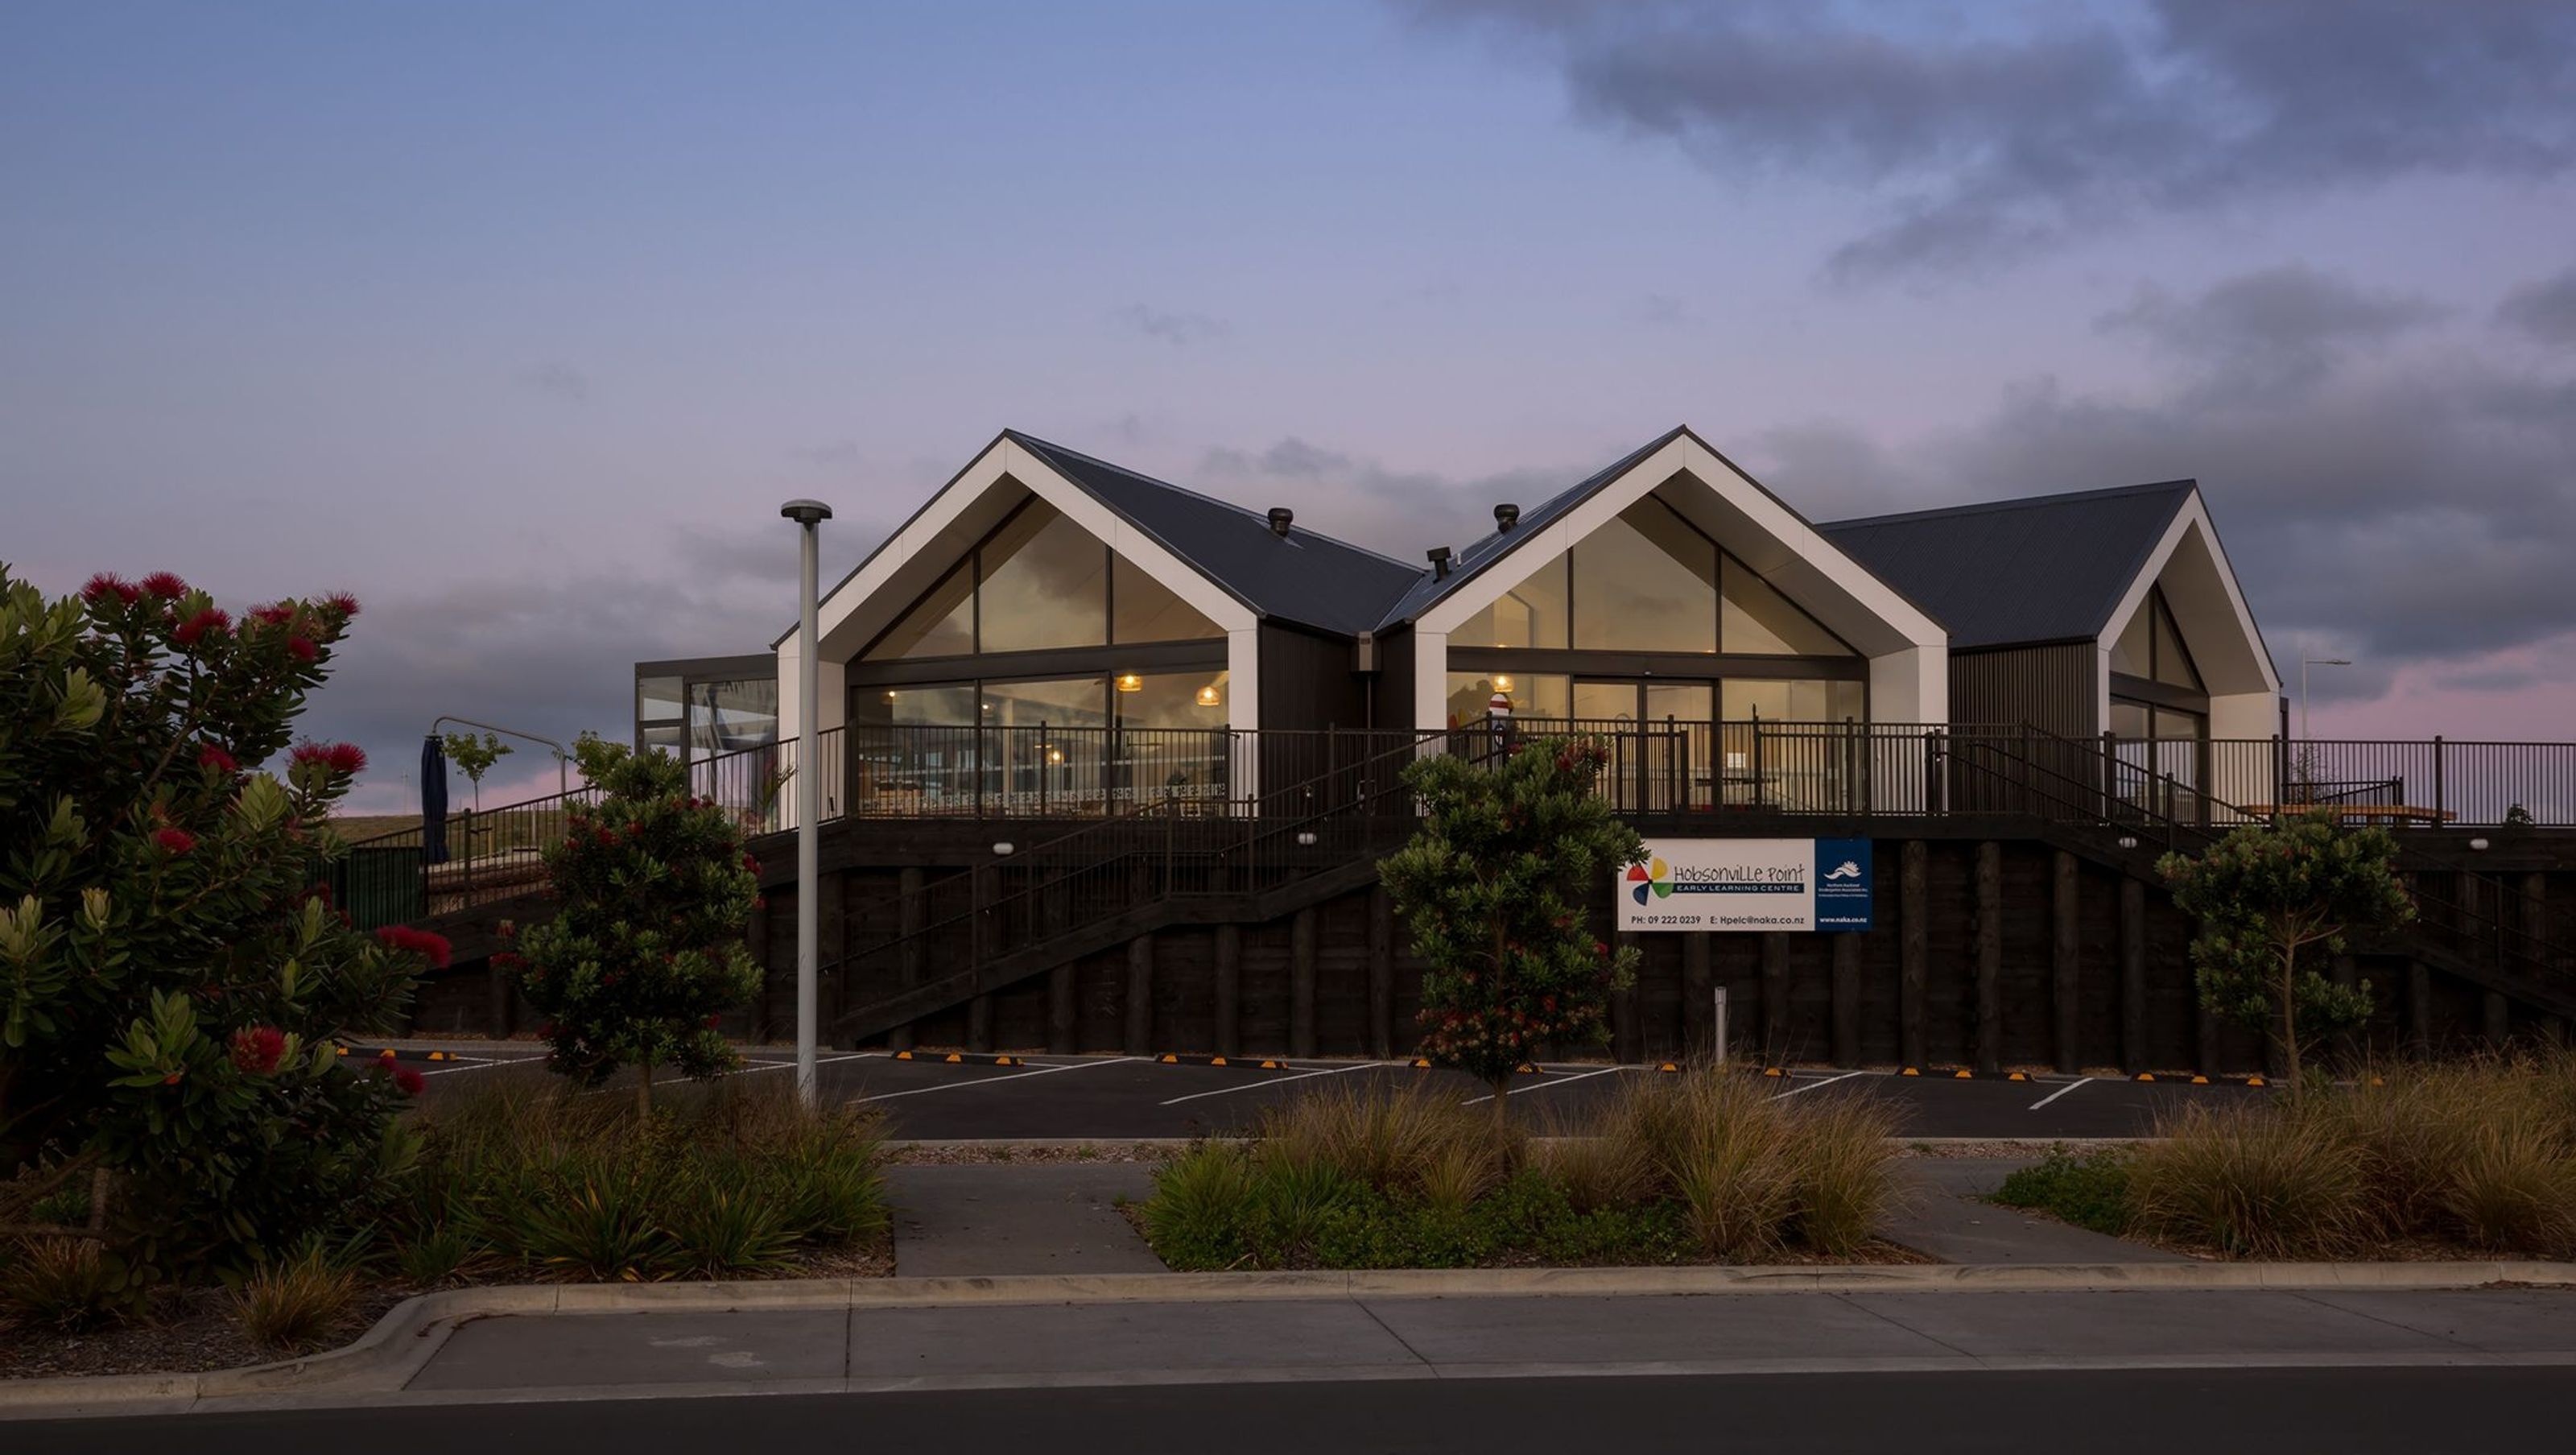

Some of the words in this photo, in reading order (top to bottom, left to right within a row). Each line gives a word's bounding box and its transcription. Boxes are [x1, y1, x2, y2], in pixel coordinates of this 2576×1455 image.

[1768, 864, 1805, 882] Point
[1631, 916, 1645, 924] PH:
[1648, 916, 1658, 924] 09
[1661, 916, 1677, 924] 222
[1679, 916, 1701, 924] 0239
[1710, 916, 1717, 924] E:
